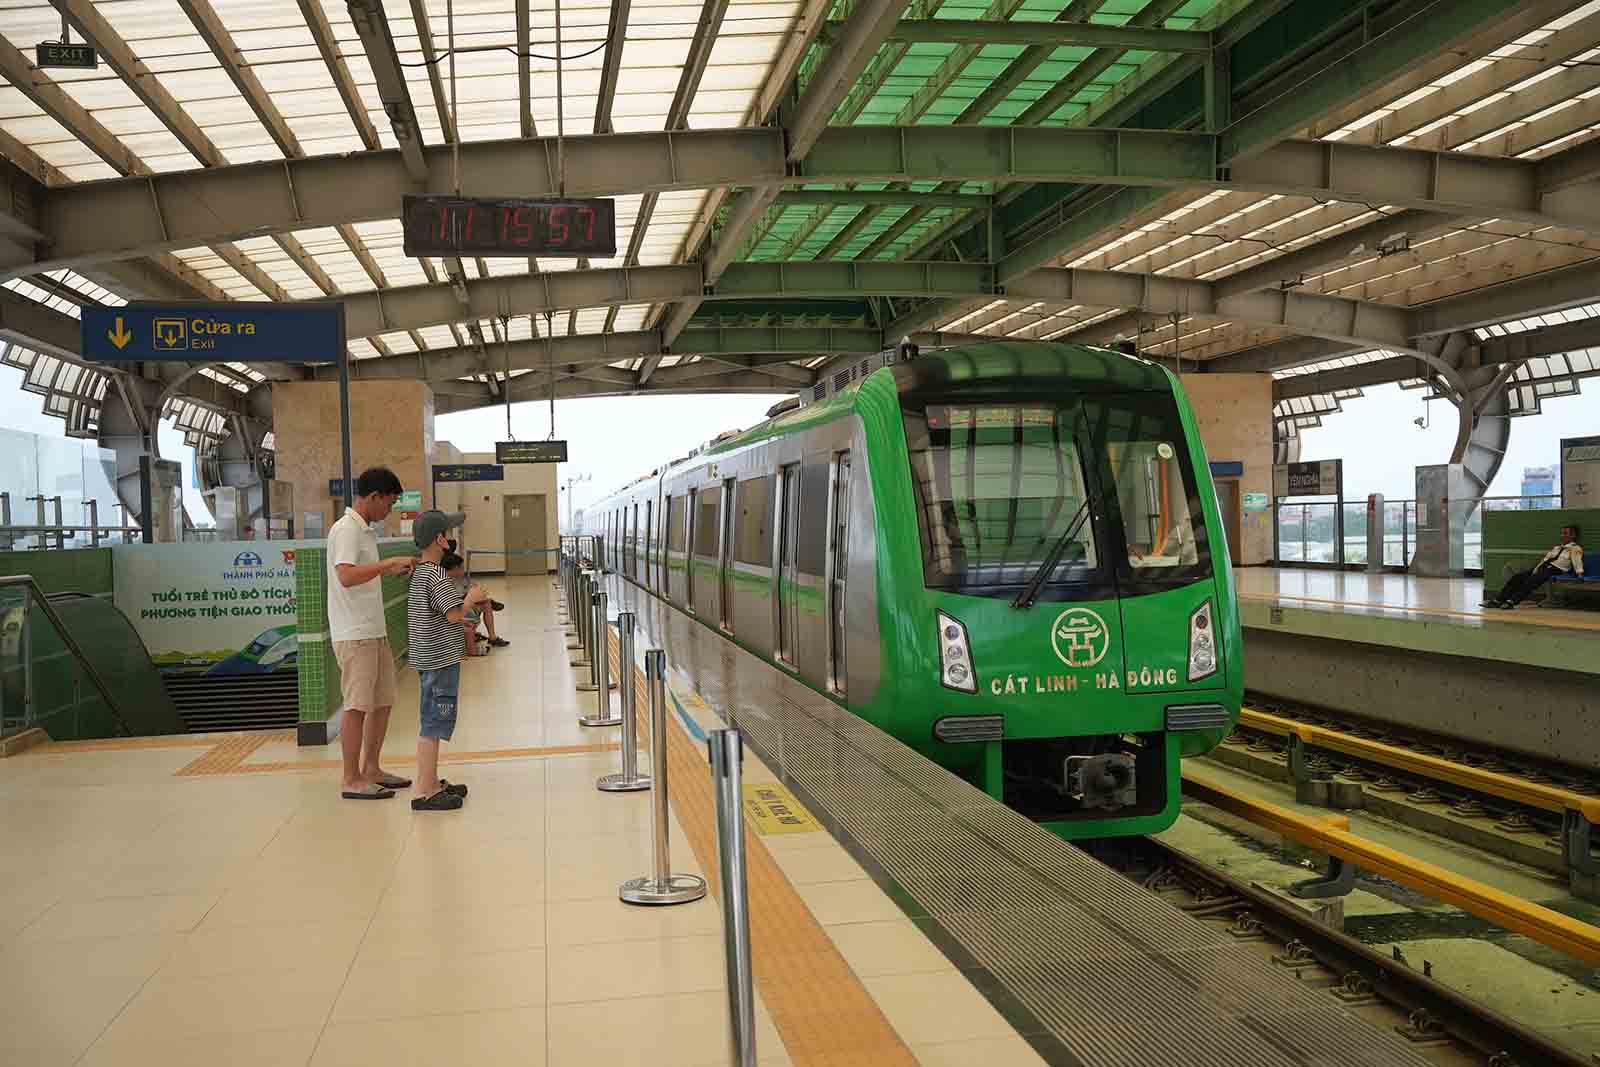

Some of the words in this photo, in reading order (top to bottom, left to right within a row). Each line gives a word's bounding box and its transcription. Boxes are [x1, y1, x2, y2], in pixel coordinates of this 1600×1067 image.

[192, 318, 231, 335] Cửa
[237, 322, 256, 335] ra
[192, 339, 215, 349] Exit
[256, 568, 275, 579] PHỐ
[240, 588, 259, 600] ĐÔ
[263, 587, 292, 599] TÍCH
[141, 607, 197, 619] PHƯƠNG
[200, 605, 228, 619] TIỆN
[231, 606, 261, 617] GIAO
[991, 674, 1029, 695] CÁT
[1036, 675, 1078, 693] LINH
[1095, 670, 1120, 689] HÀ
[1127, 666, 1177, 689] ĐÔNG
